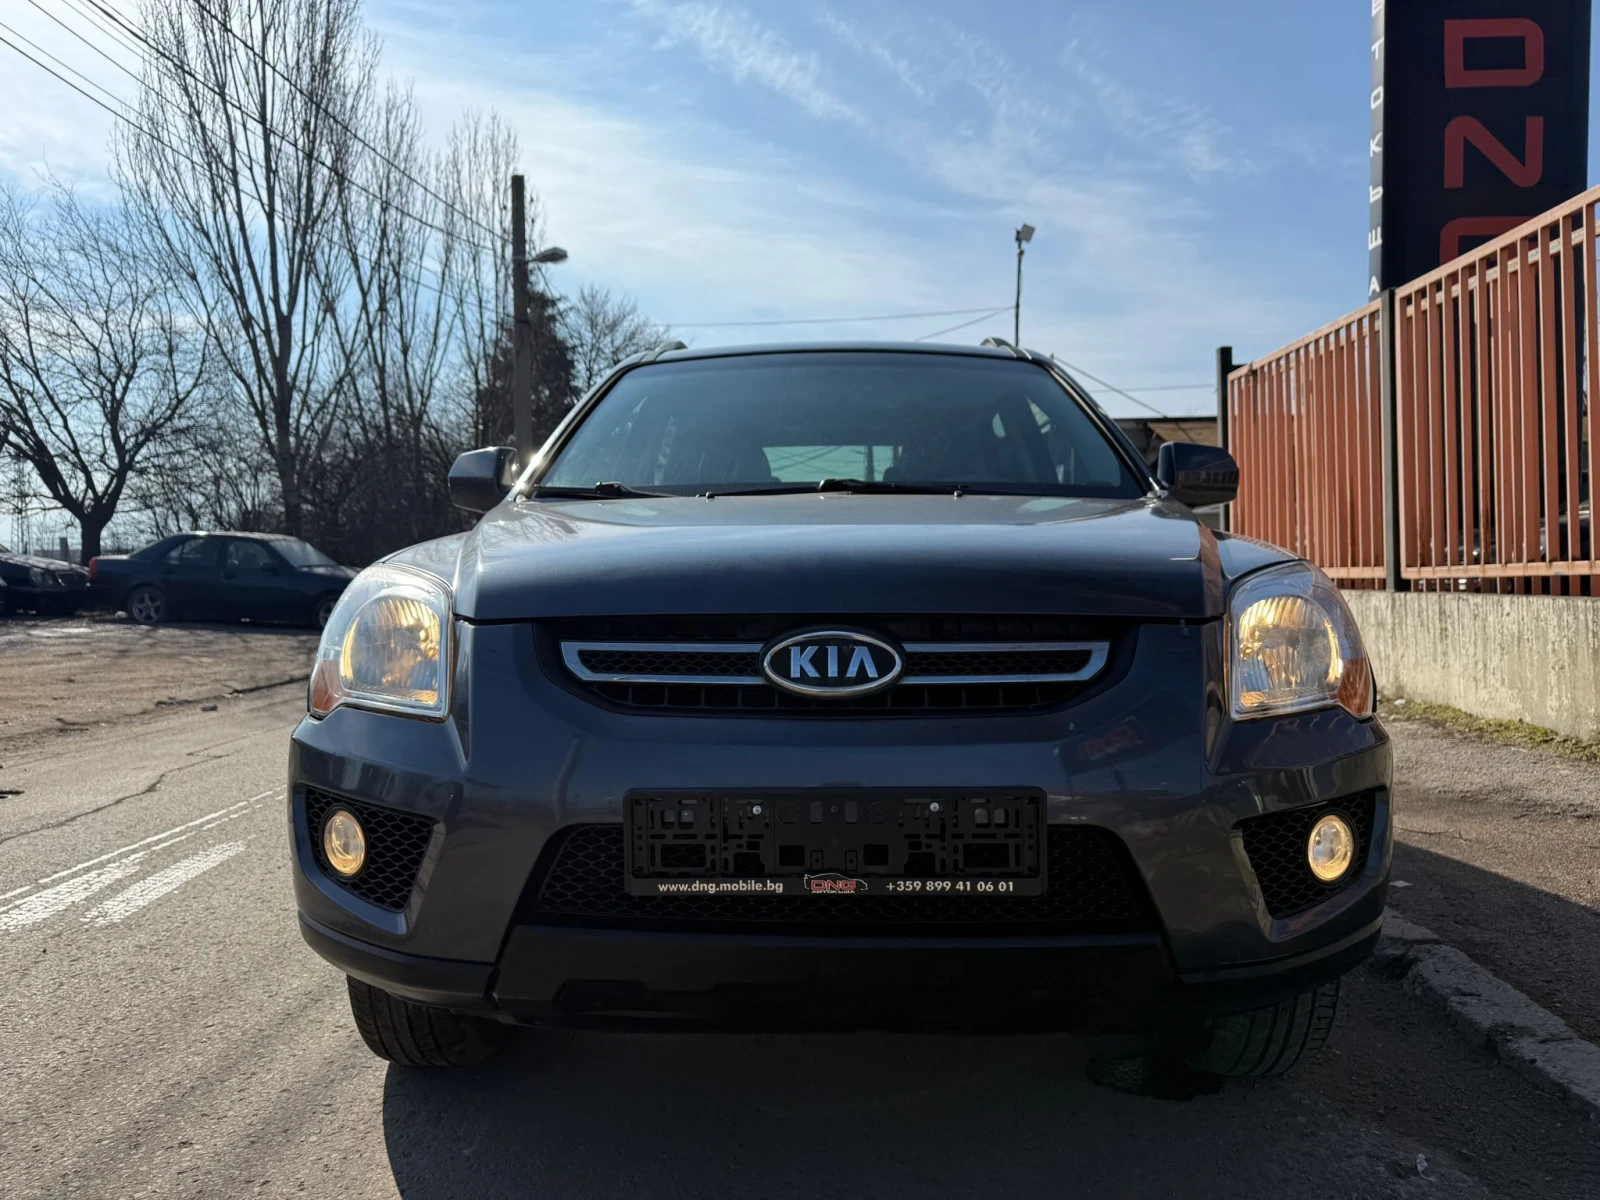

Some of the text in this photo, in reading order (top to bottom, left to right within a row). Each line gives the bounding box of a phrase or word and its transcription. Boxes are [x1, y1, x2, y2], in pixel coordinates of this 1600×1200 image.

[789, 645, 879, 678] KIA
[658, 879, 783, 894] www.dng.mobile.bg
[811, 879, 856, 891] DNG
[886, 880, 1014, 892] +359 899 41 06 01
